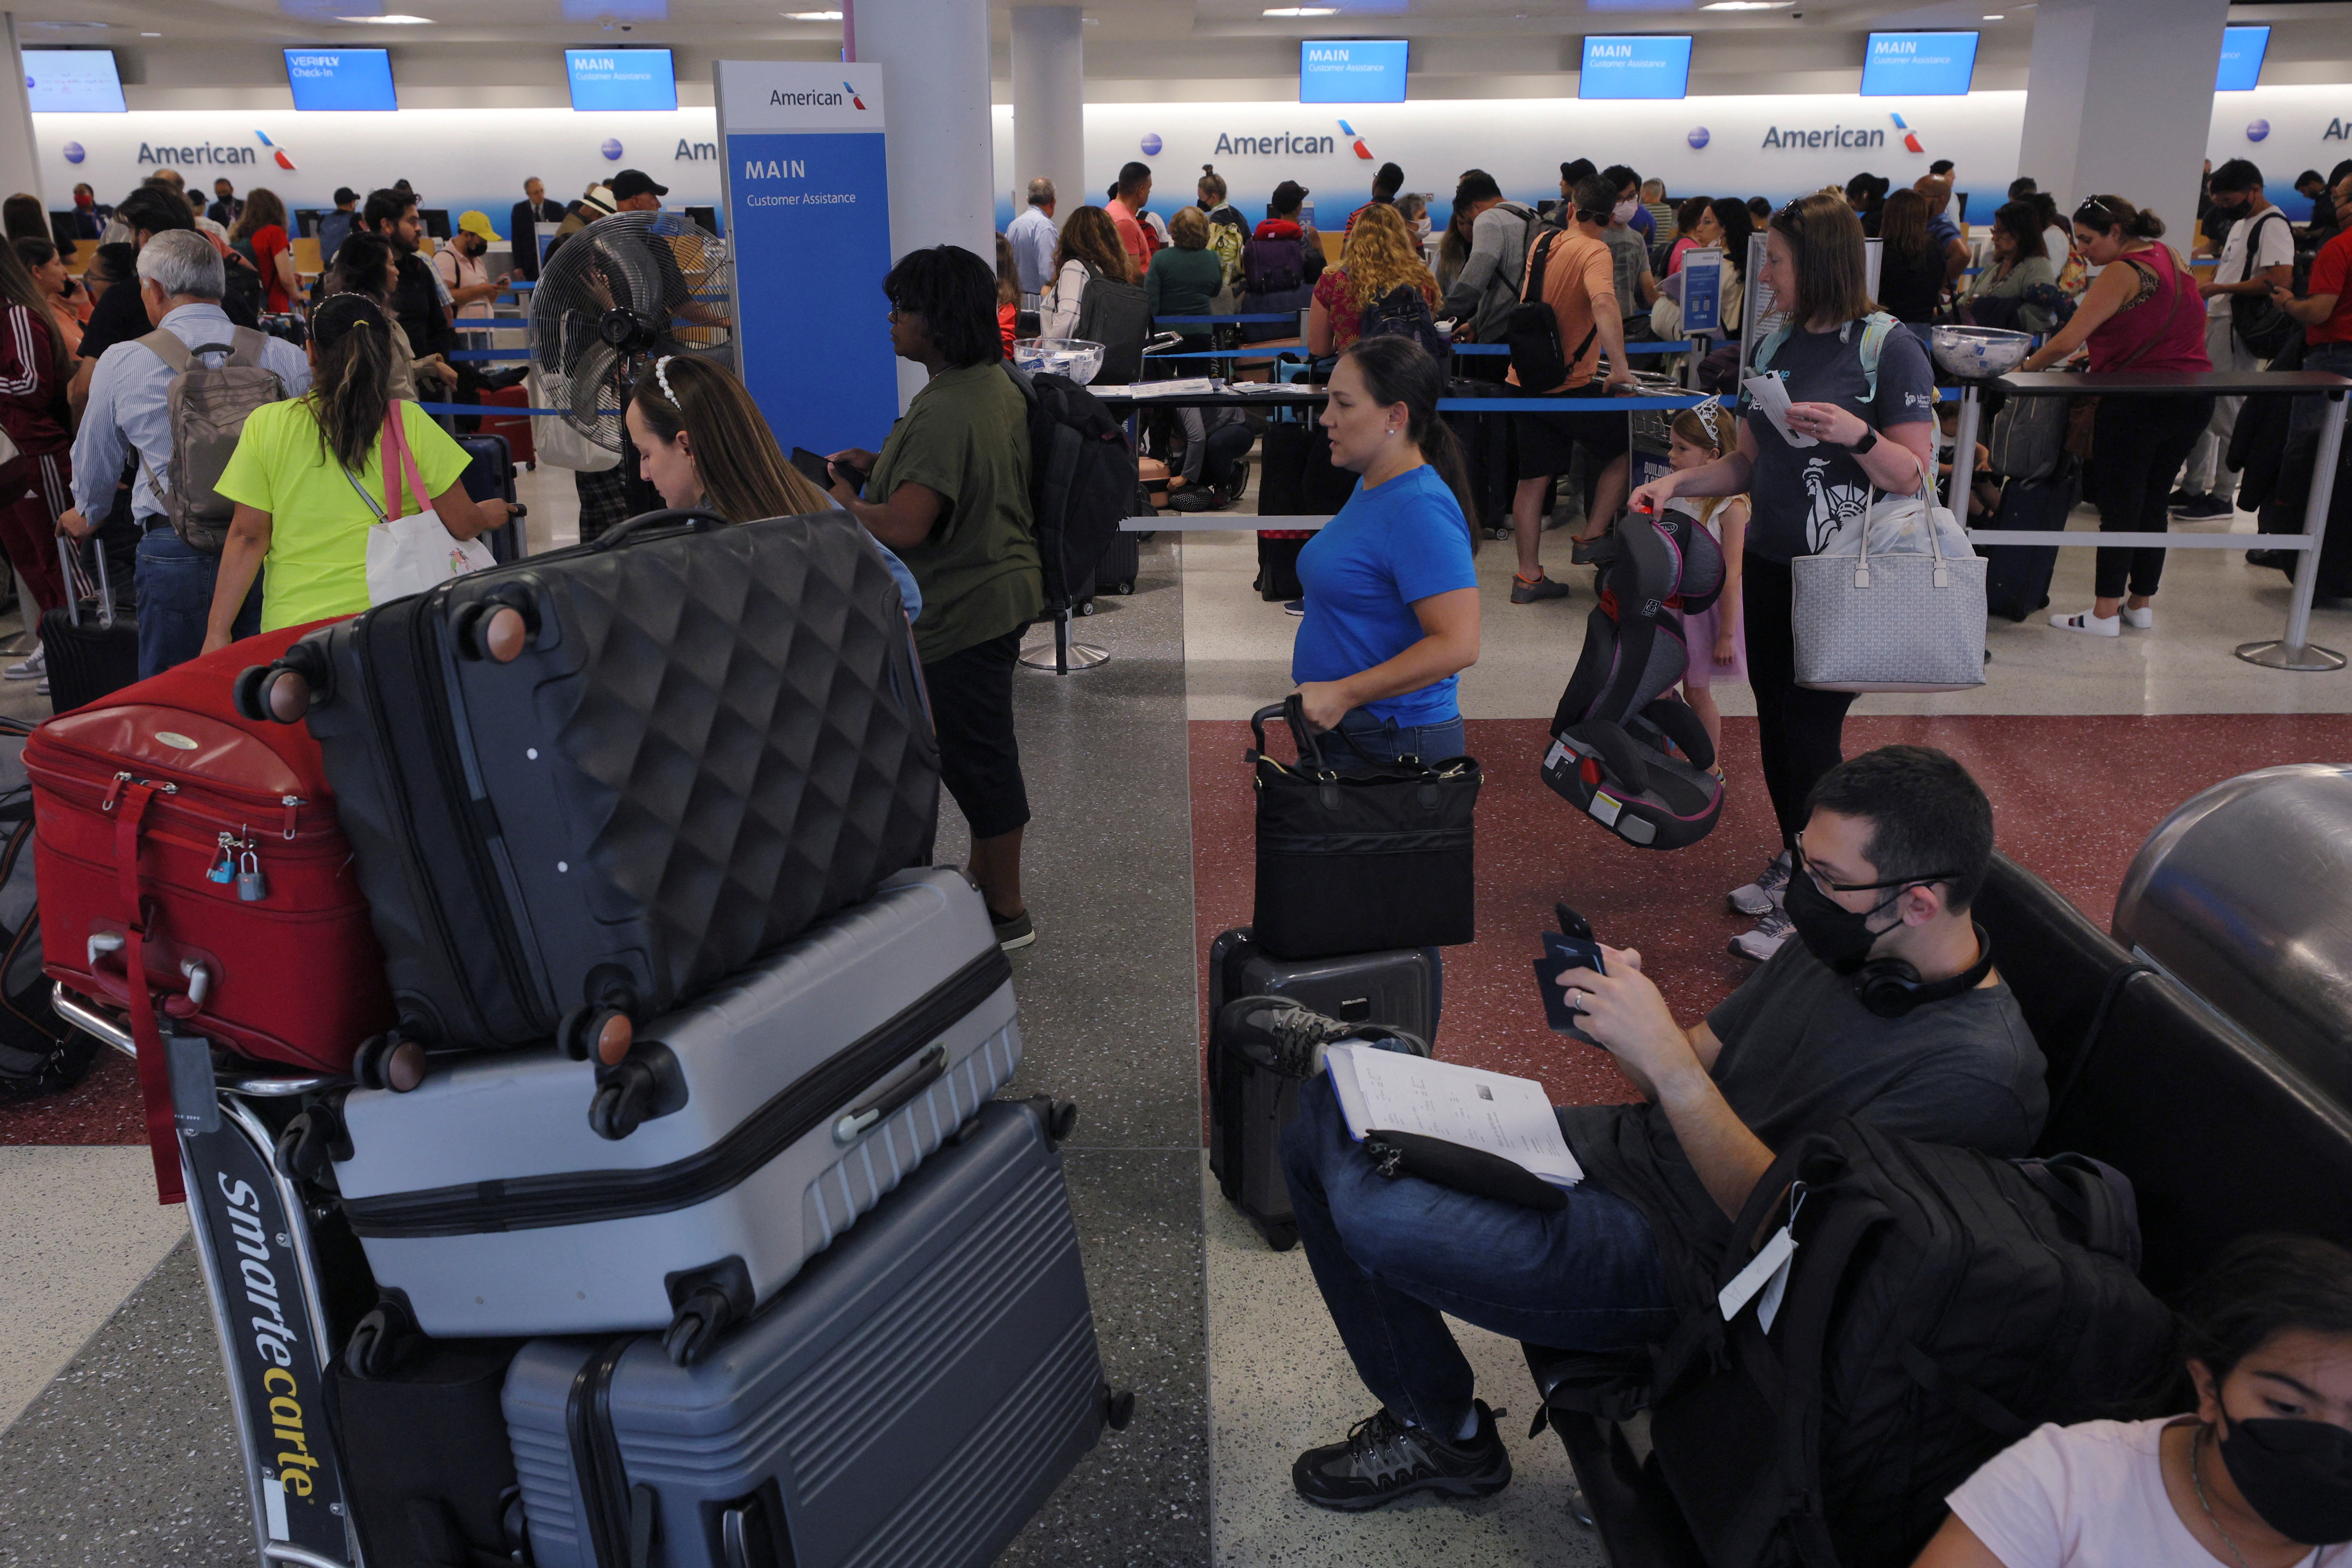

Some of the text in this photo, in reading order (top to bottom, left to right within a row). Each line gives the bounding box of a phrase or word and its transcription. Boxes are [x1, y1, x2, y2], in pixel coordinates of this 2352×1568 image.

[1590, 45, 1631, 57] MAIN
[1875, 41, 1916, 54] MAIN
[291, 56, 339, 66] VERIFLY
[1309, 49, 1349, 61] MAIN
[1873, 55, 1951, 64] Customer Assistance
[574, 58, 614, 70] MAIN
[1309, 63, 1384, 72] Customer Assistance
[1590, 59, 1666, 68] Customer Assistance
[293, 67, 333, 77] Check-In
[576, 72, 651, 80] Customer Assistance
[770, 90, 842, 106] American
[1762, 125, 1884, 148] American
[1215, 131, 1334, 155] American
[138, 142, 255, 164] American
[746, 160, 805, 179] MAIN
[747, 192, 856, 207] Customer Assistance
[218, 1171, 319, 1496] smartecarte
